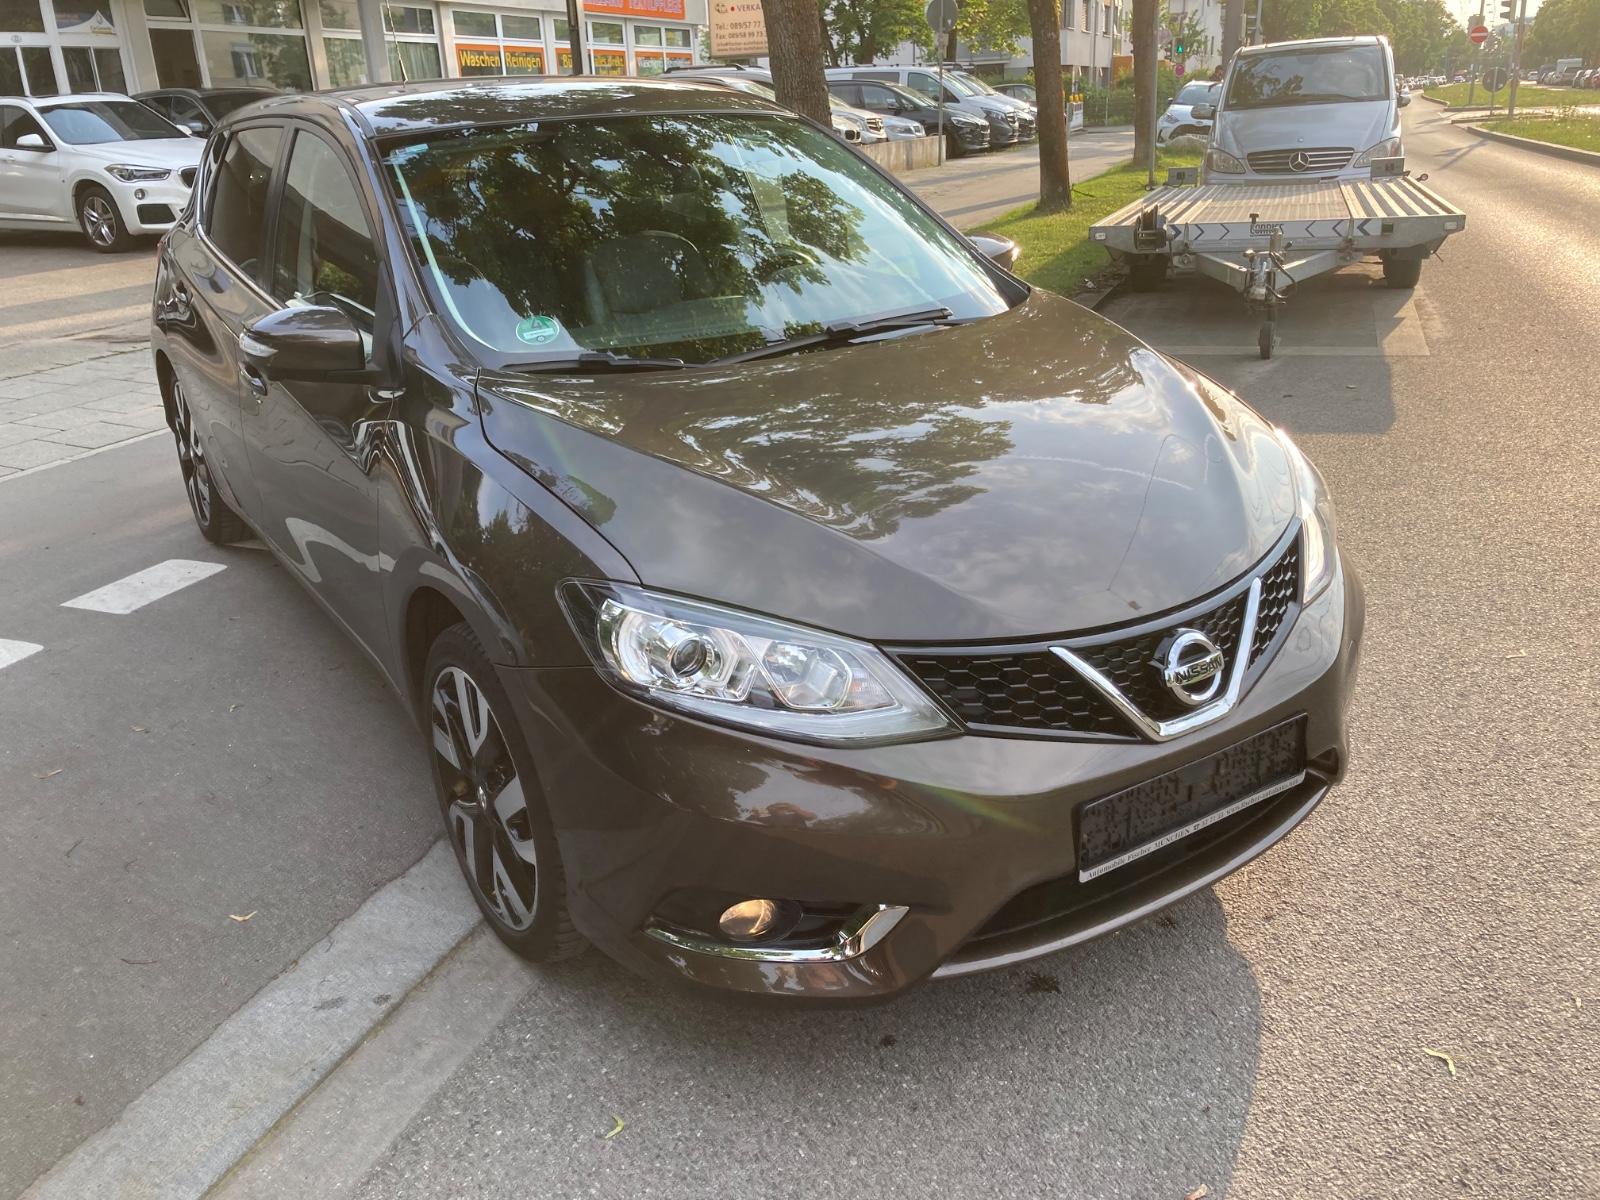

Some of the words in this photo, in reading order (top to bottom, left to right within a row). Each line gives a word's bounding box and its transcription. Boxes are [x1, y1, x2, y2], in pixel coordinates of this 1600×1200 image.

[459, 50, 500, 66] Waschen
[505, 52, 541, 71] Reinigen
[1174, 653, 1222, 684] NISSAN
[1088, 856, 1125, 879] Automobile
[1127, 846, 1151, 861] Fischer
